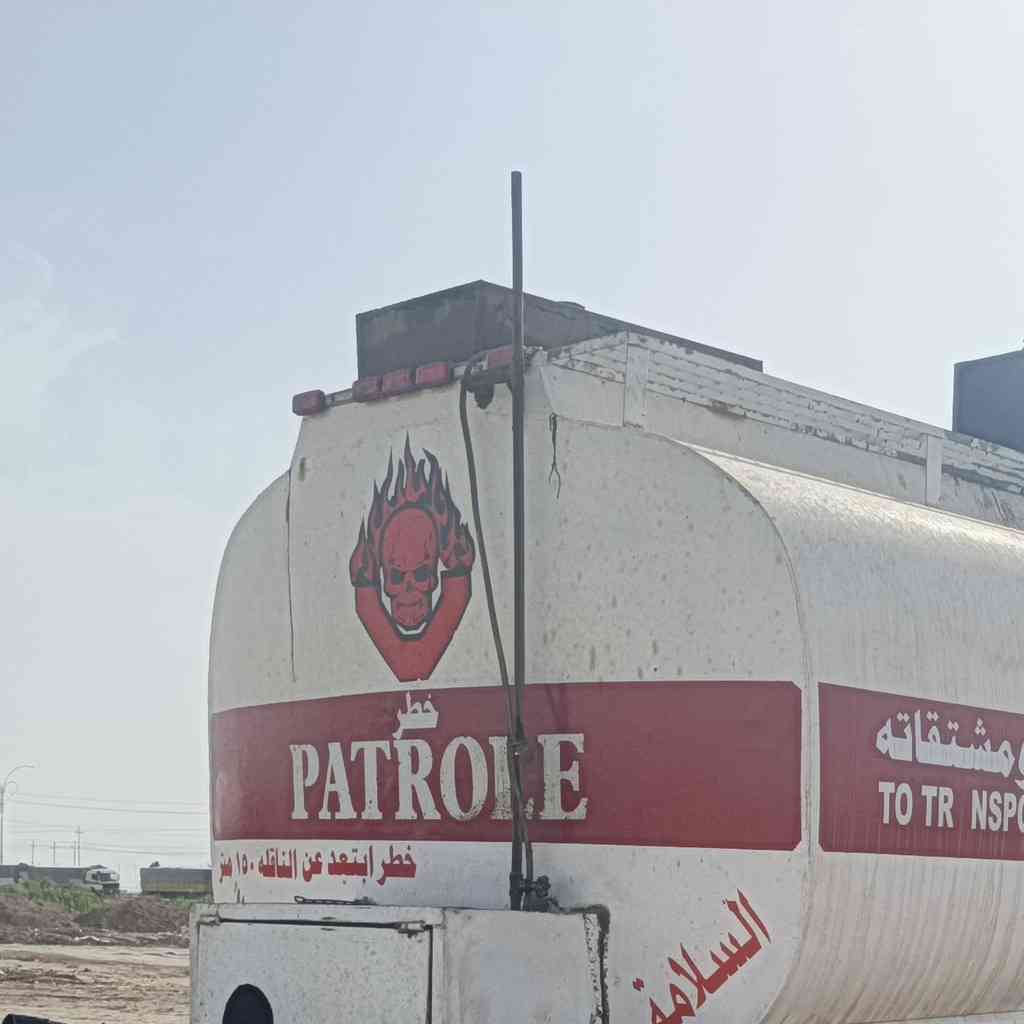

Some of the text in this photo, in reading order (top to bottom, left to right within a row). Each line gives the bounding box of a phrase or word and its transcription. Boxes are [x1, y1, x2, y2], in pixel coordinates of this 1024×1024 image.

[392, 691, 439, 739] خطر
[878, 781, 913, 826] TO
[303, 852, 322, 882] عن
[328, 845, 373, 884] ابتعد
[377, 845, 416, 885] خطر
